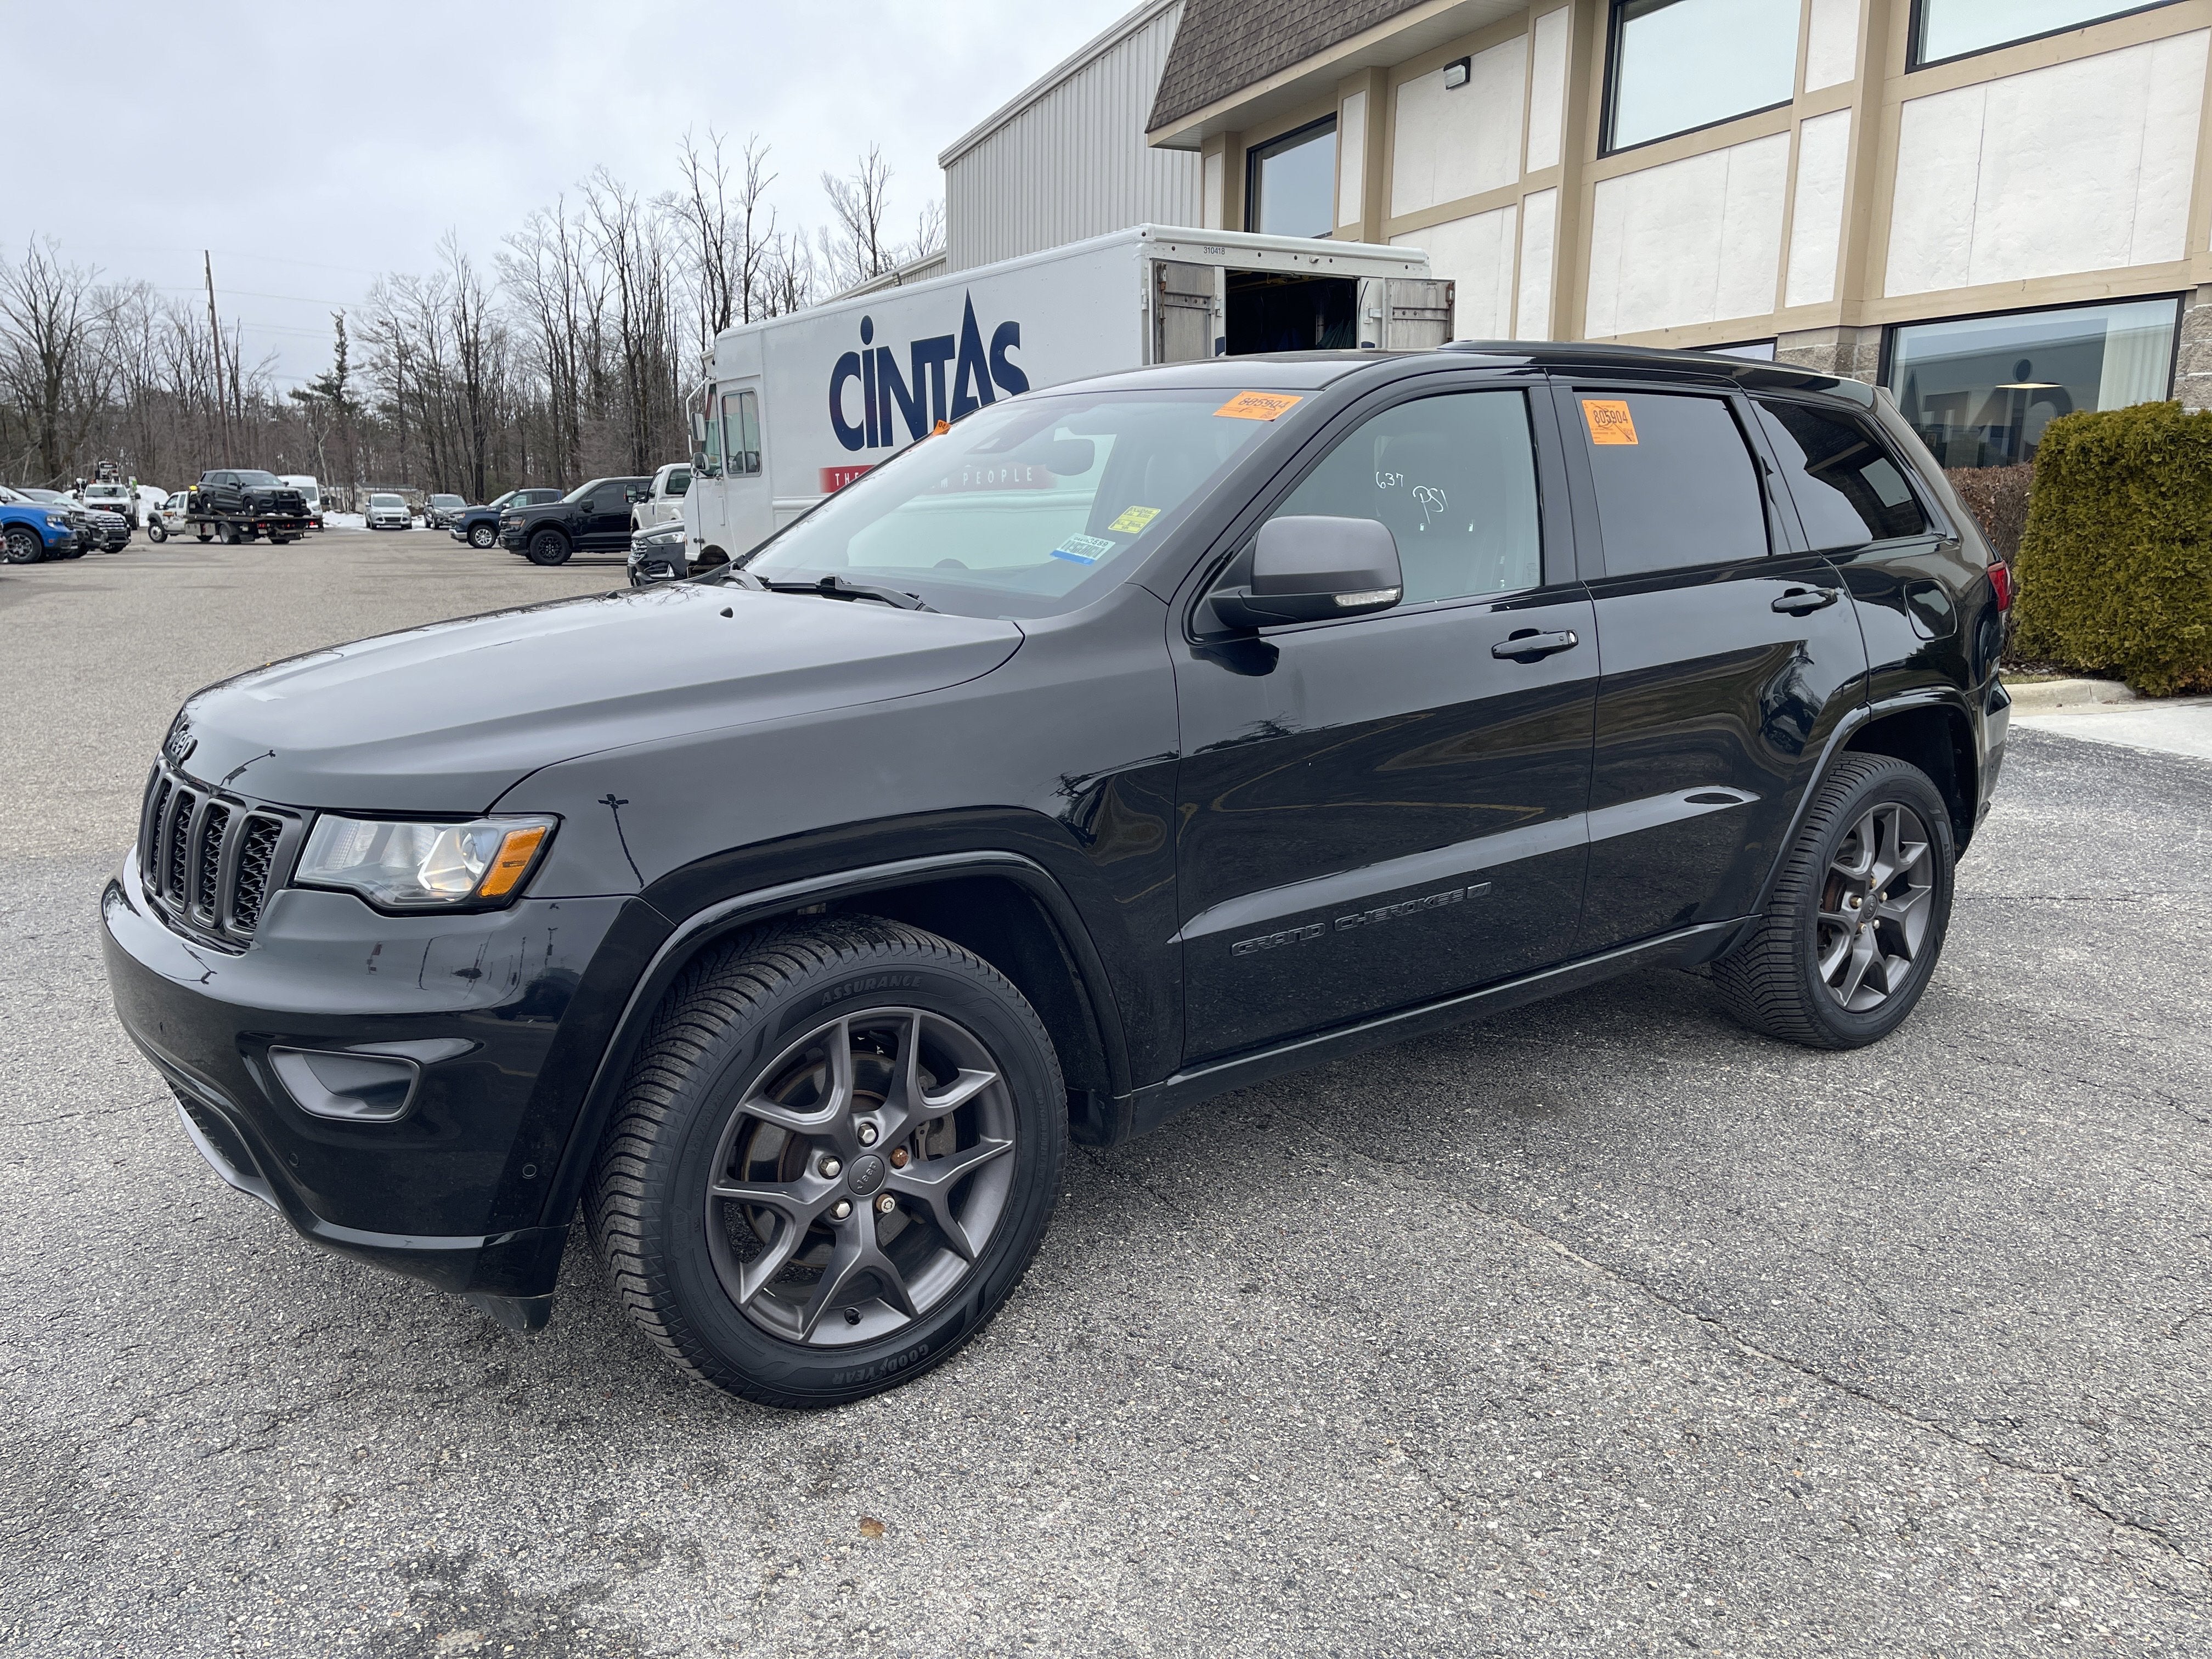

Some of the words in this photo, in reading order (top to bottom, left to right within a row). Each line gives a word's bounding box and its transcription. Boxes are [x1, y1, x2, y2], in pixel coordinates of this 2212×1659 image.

[1203, 246, 1225, 255] 310418
[829, 286, 1030, 452] CINTAS
[1593, 410, 1628, 424] 805904
[963, 467, 1032, 486] PEOPLE
[1376, 471, 1403, 489] 637
[1231, 922, 1326, 957] GRAND
[1334, 888, 1464, 932] CHEROKEE
[821, 975, 923, 1006] ASSURANCE
[856, 1160, 877, 1190] Jeep
